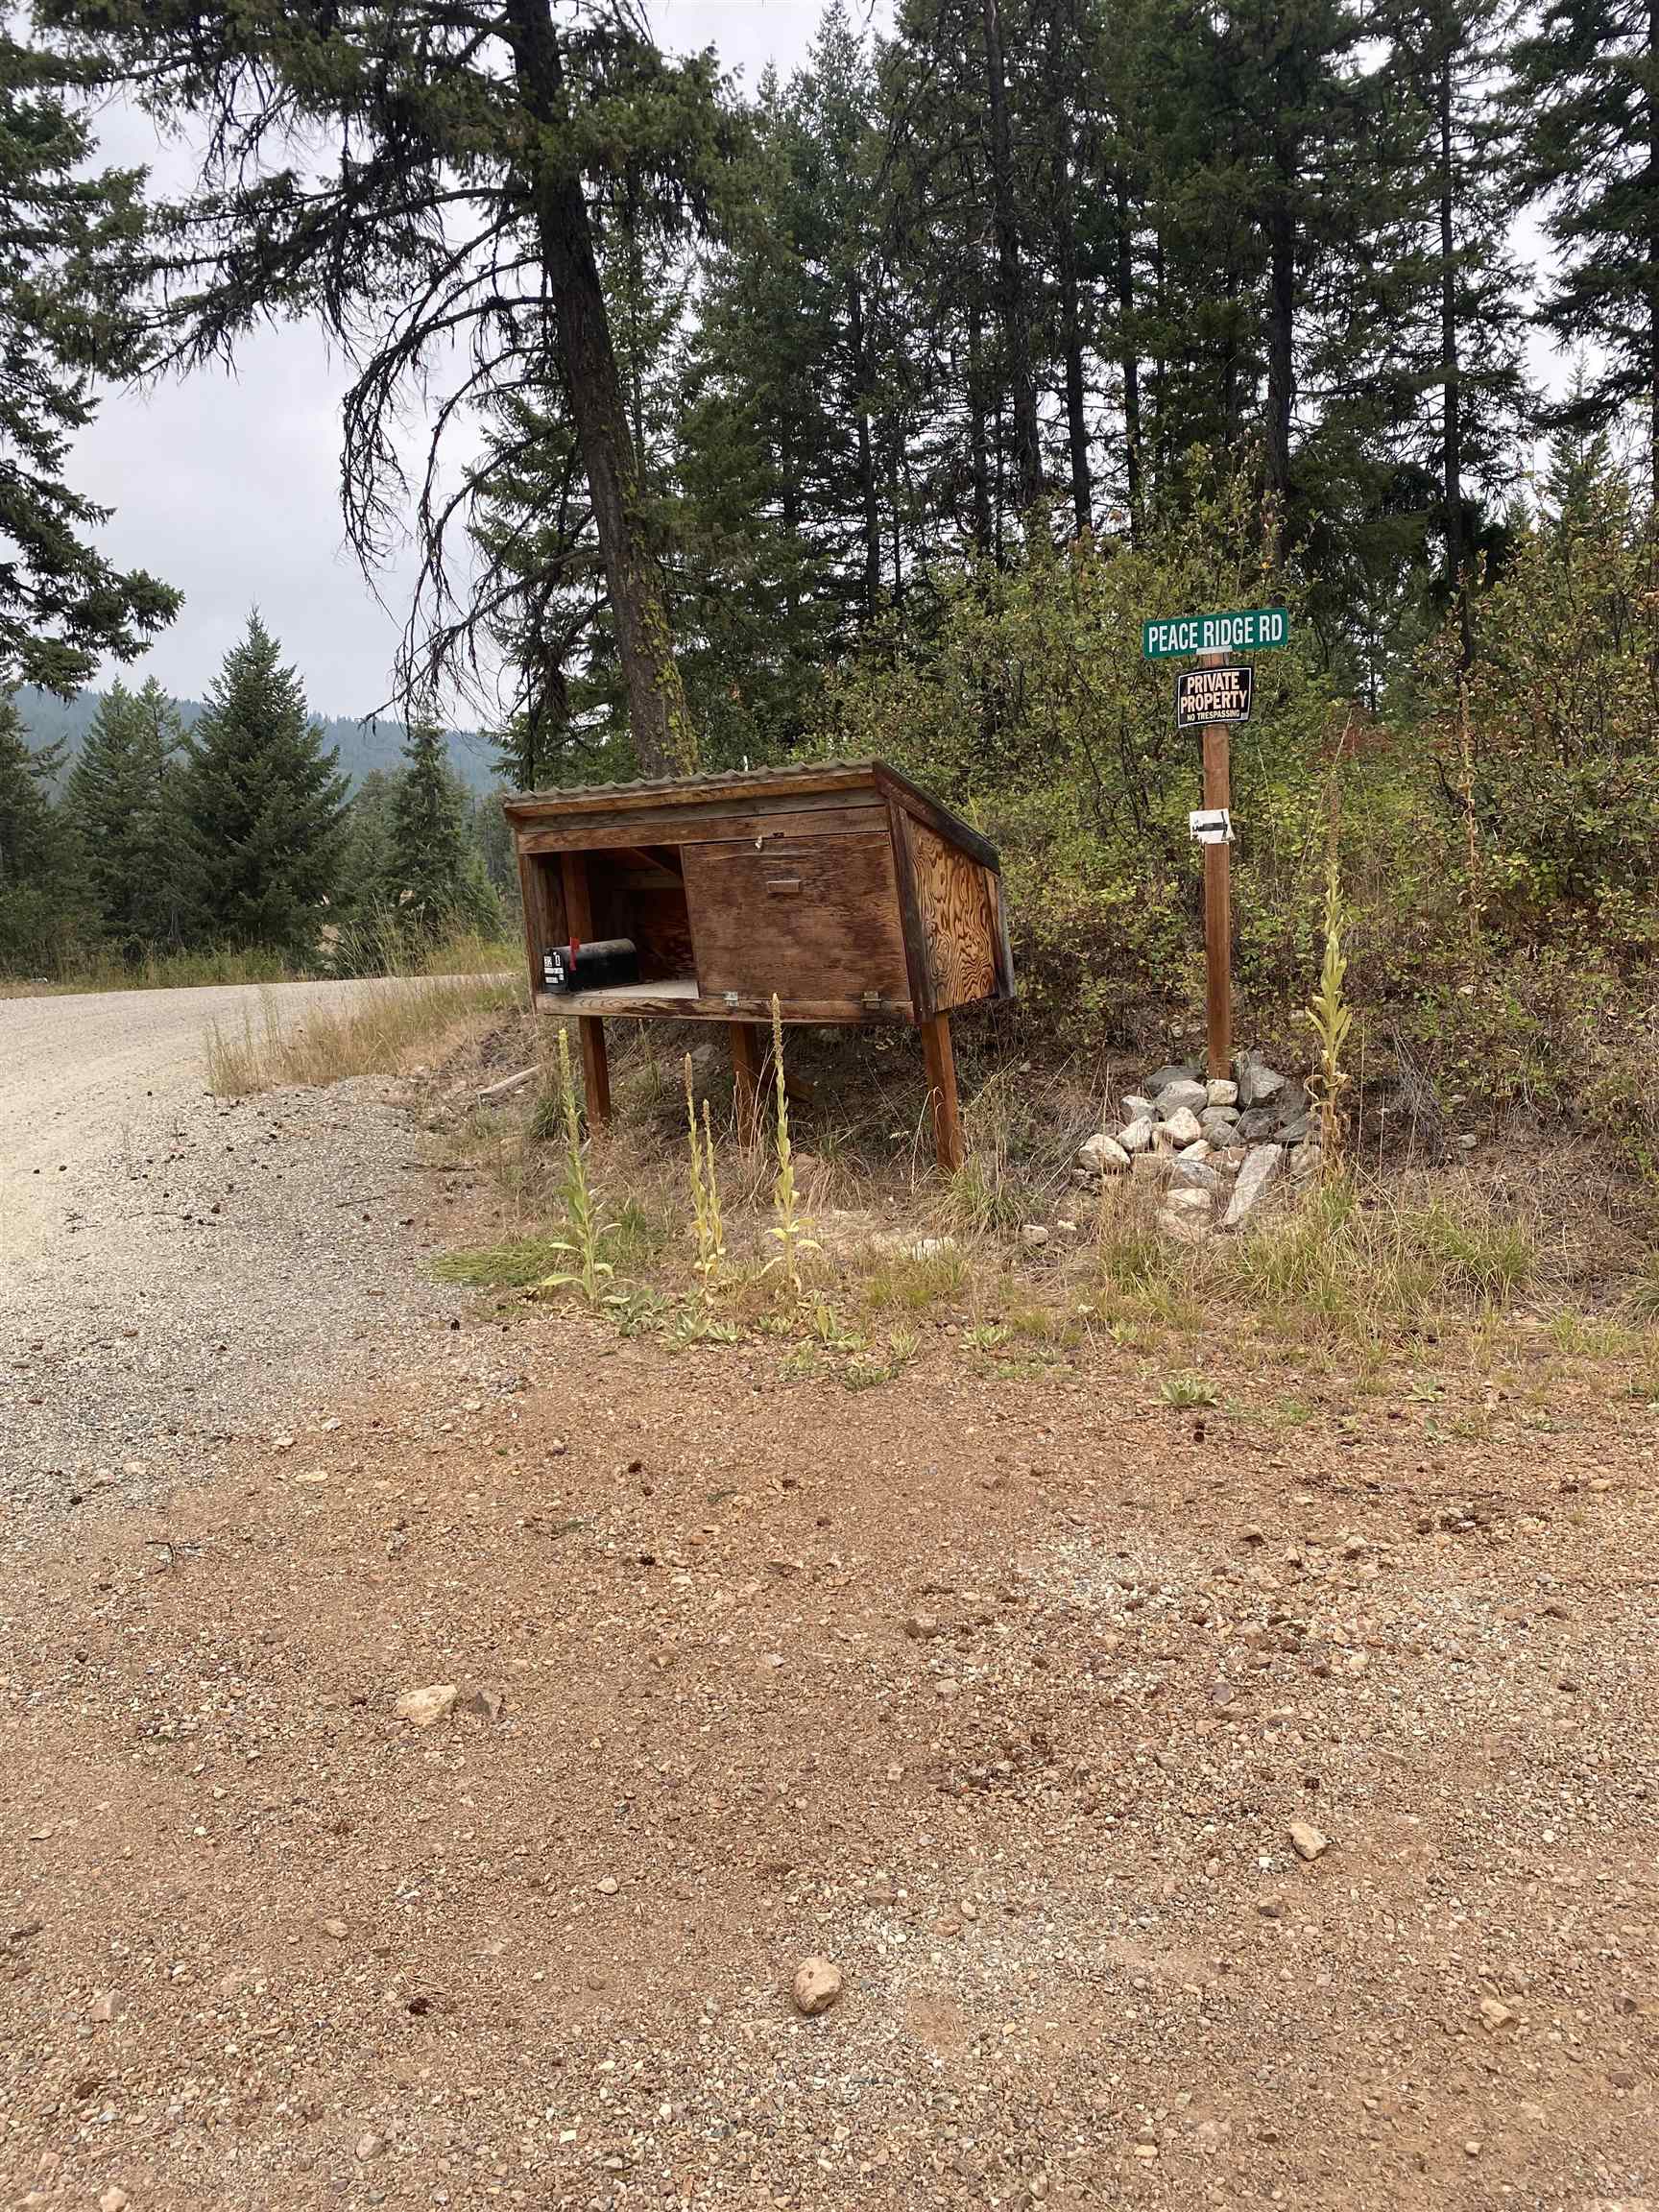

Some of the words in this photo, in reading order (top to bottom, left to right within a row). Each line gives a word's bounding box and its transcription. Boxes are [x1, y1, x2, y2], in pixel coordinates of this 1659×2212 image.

[1148, 622, 1198, 653] PEACE
[1203, 616, 1254, 647] RIDGE
[1259, 613, 1283, 642] RD
[1187, 671, 1240, 695] PRIVATE
[1180, 689, 1248, 714] PROPERTY
[1187, 713, 1195, 723] NO
[1197, 709, 1240, 721] TRESPASSING
